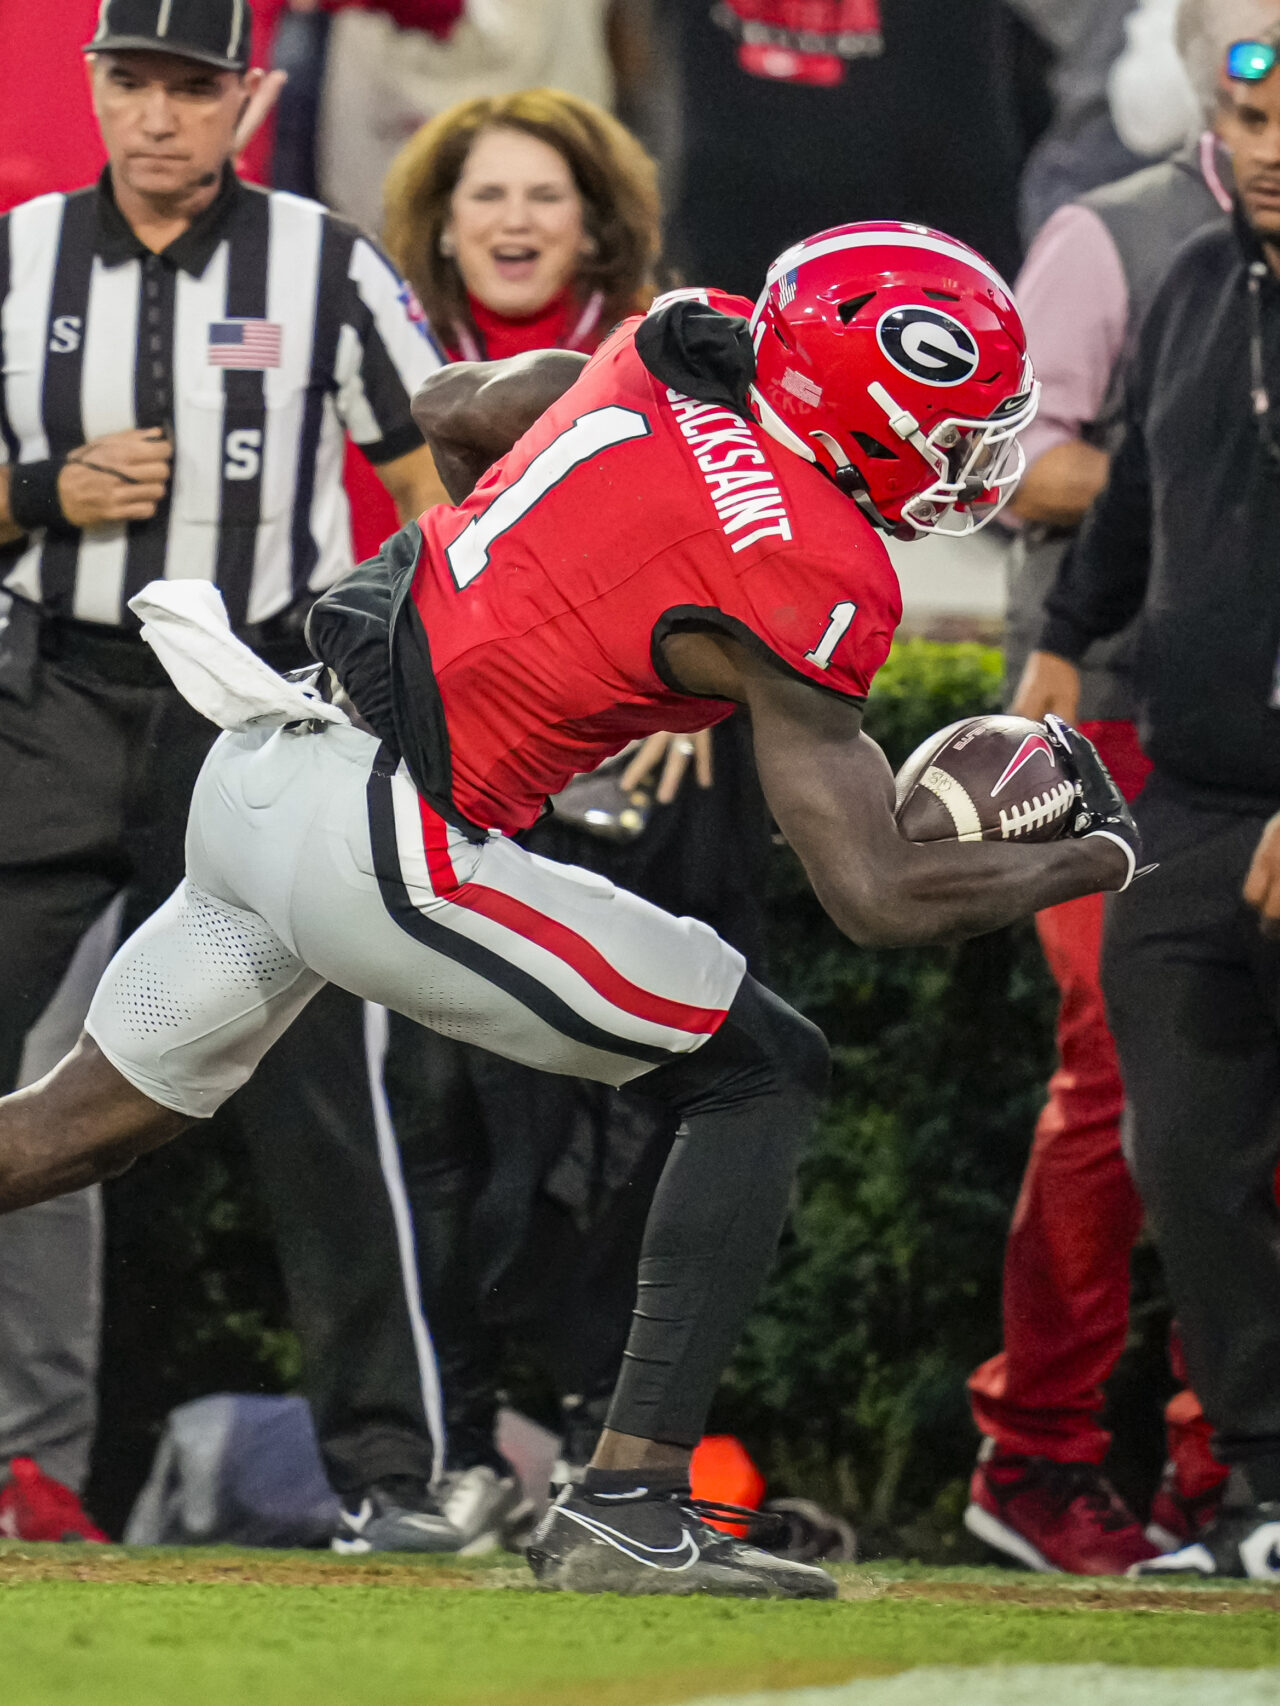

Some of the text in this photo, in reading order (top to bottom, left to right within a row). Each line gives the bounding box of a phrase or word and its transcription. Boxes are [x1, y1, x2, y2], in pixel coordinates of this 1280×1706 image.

[49, 315, 82, 353] S
[890, 312, 978, 378] G
[224, 428, 262, 481] S
[665, 387, 793, 554] ACKSAINT
[445, 404, 653, 593] 1
[802, 600, 857, 671] 1
